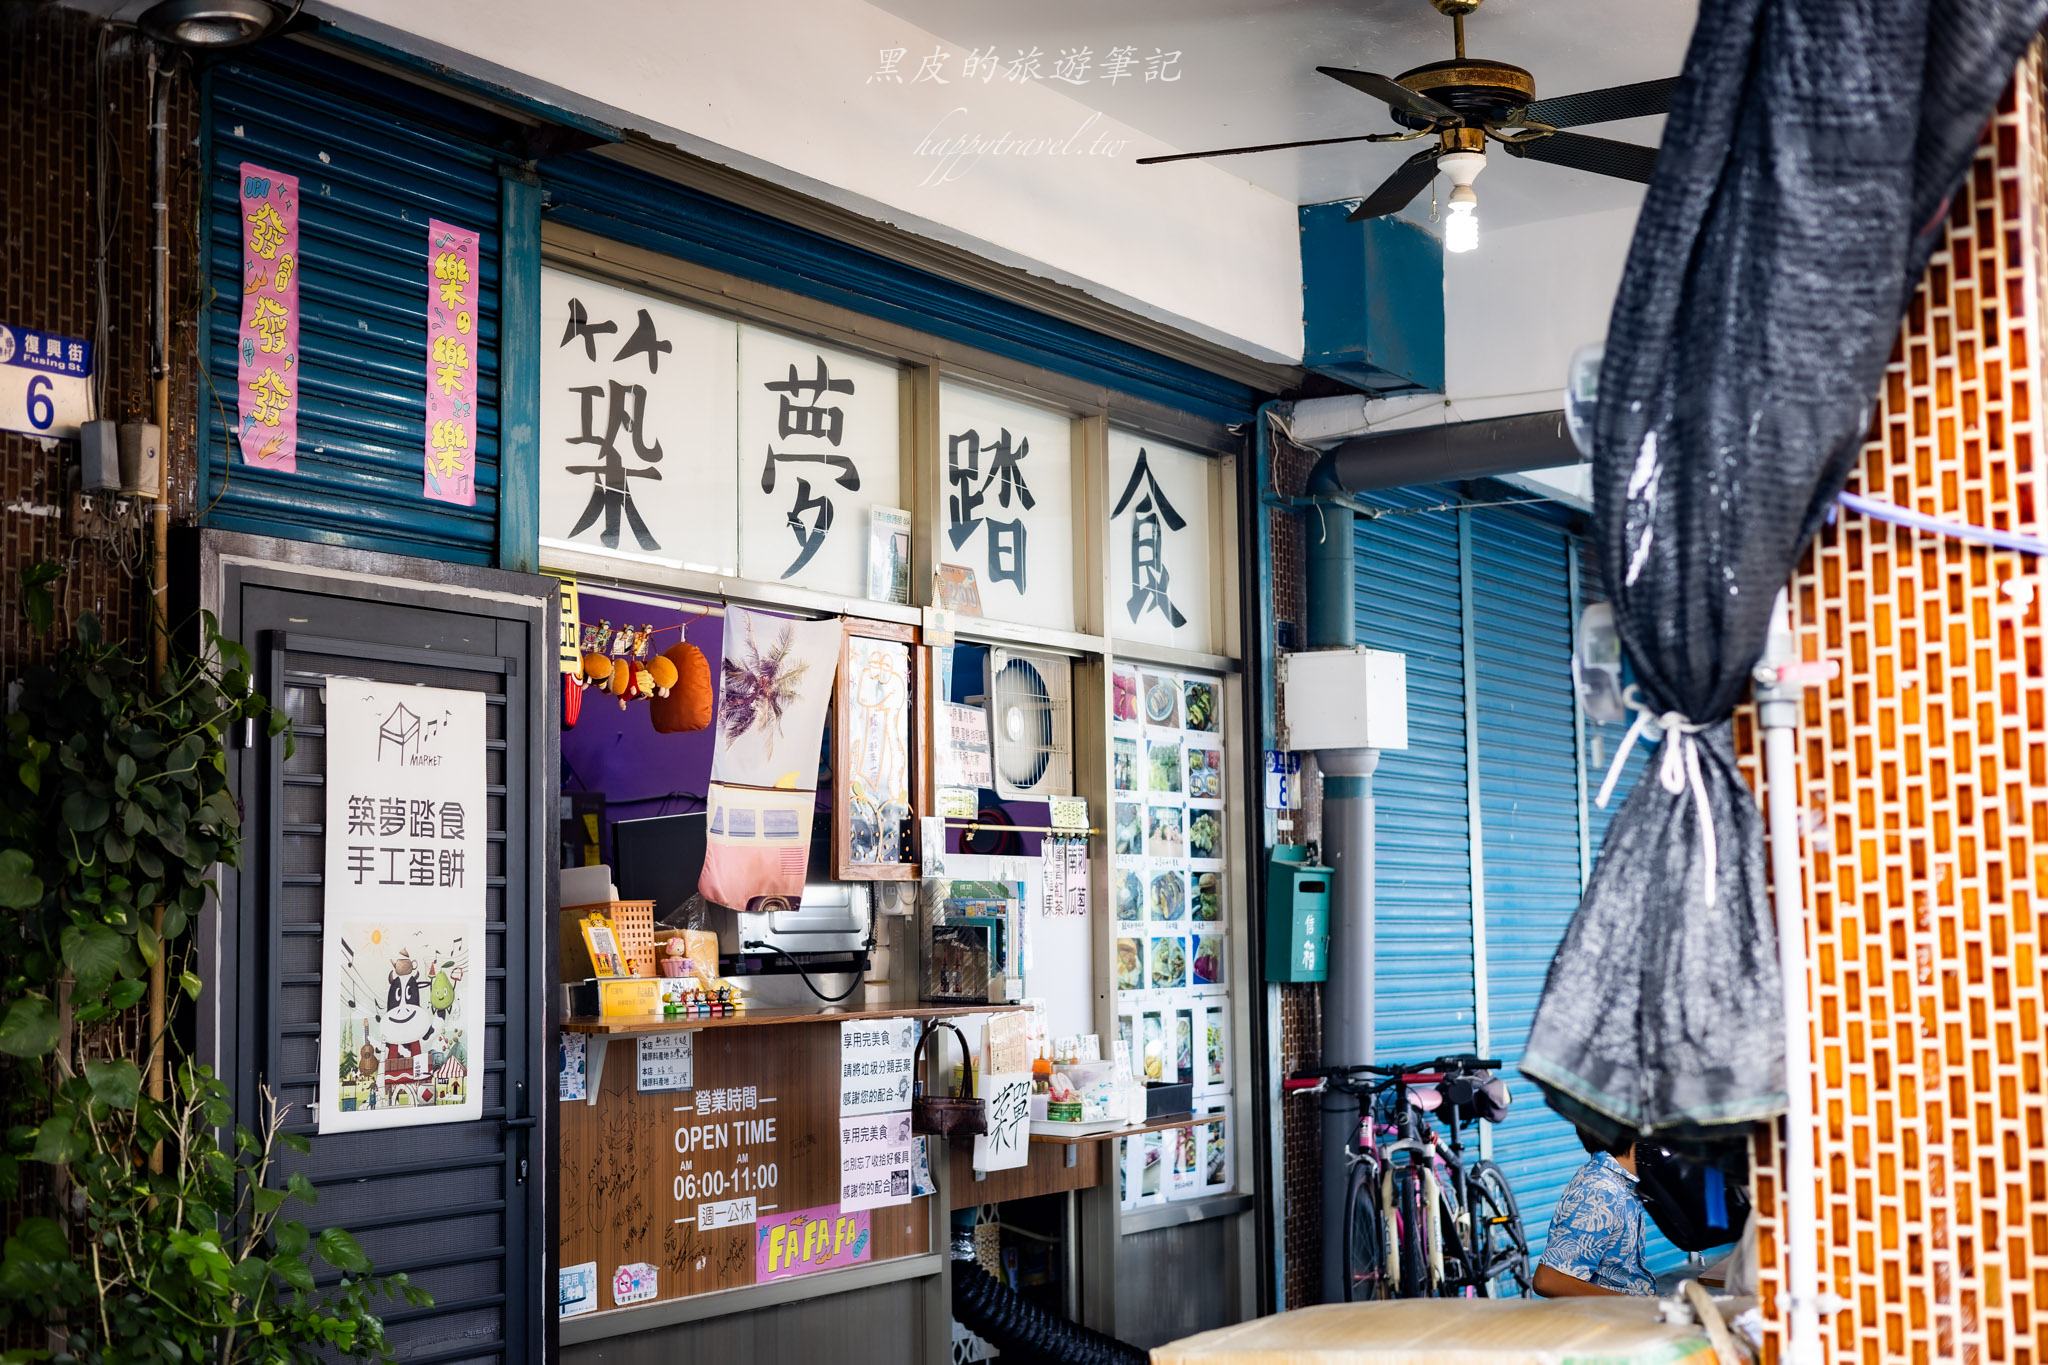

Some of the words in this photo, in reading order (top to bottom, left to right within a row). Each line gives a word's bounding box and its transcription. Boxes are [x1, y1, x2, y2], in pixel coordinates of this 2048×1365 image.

[25, 333, 83, 363] 復興街
[24, 353, 66, 370] Fusing
[68, 361, 84, 373] St.
[27, 375, 54, 430] 6
[560, 297, 1187, 629] 築夢踏食
[410, 753, 443, 766] MARKET
[348, 794, 465, 840] 築夢踏食
[347, 845, 465, 888] 手工蛋餅
[1302, 914, 1316, 971] 信箱
[843, 1030, 890, 1049] 享用完美食
[843, 1058, 911, 1079] 請將垃圾分類丟棄
[695, 1086, 757, 1116] 營業時間
[989, 1080, 1031, 1155] 菜單
[674, 1122, 728, 1154] OPEN
[733, 1117, 777, 1147] TIME
[842, 1124, 888, 1145] 享用完美食
[680, 1160, 693, 1172] AM
[736, 1153, 749, 1164] AM
[843, 1150, 910, 1172] 也別忘了收拾好餐具
[673, 1163, 778, 1201] 06:00-11:00
[843, 1179, 891, 1199] 感謝您的配合
[702, 1202, 753, 1227] 週一公休
